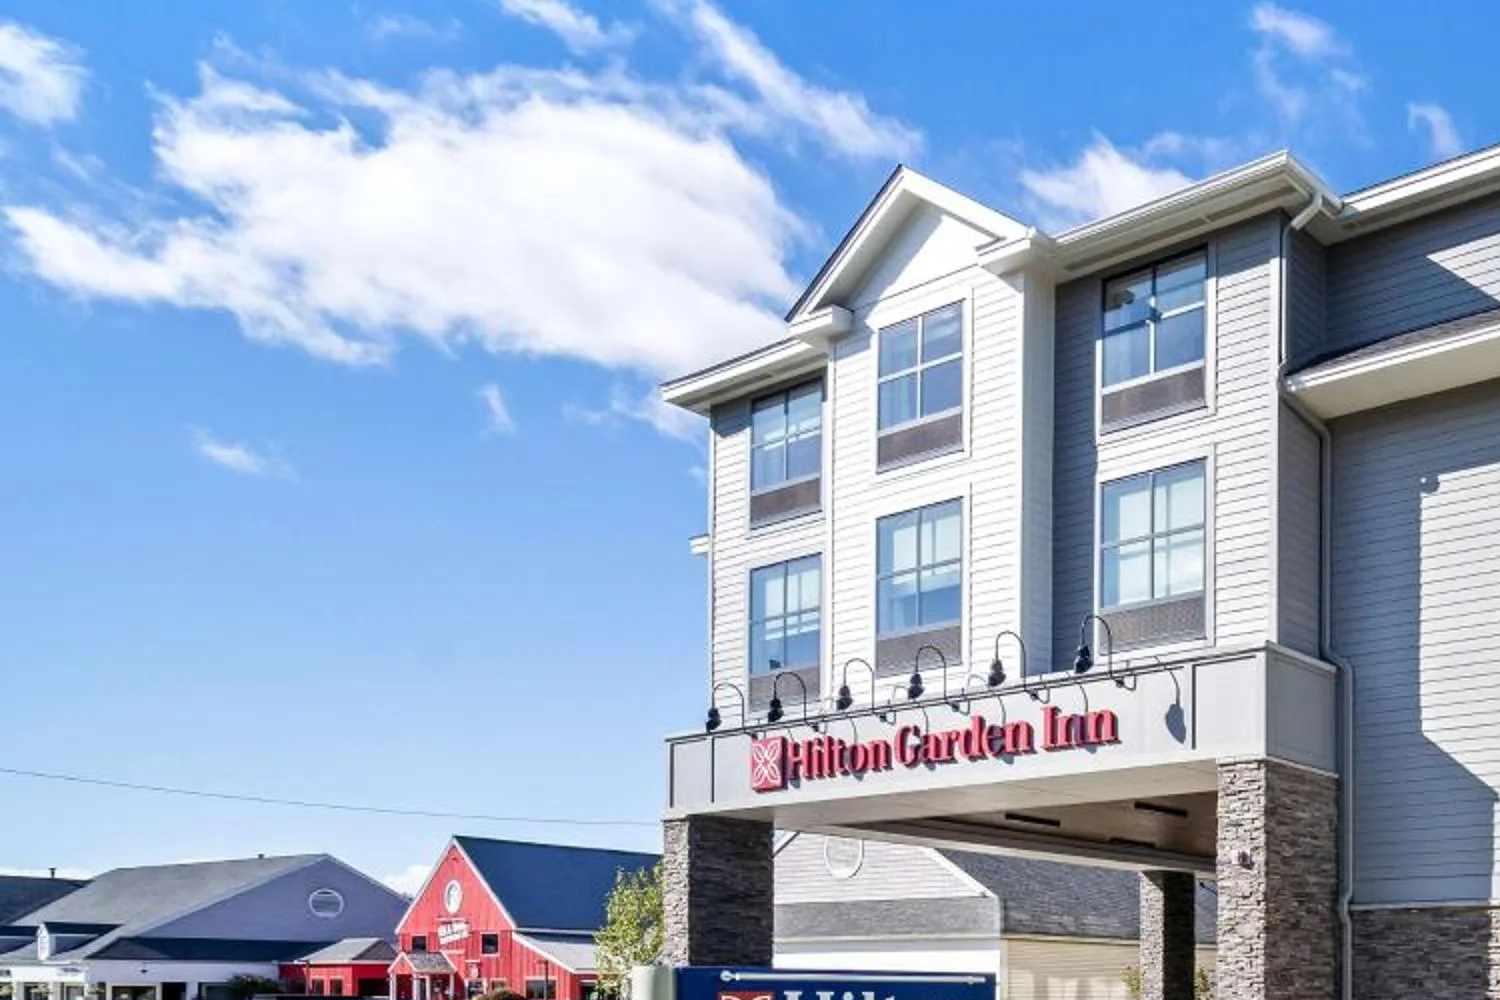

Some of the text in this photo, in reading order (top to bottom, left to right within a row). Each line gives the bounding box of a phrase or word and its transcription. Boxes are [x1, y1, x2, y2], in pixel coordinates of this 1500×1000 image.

[787, 705, 1120, 781] Hilton Garden Inn
